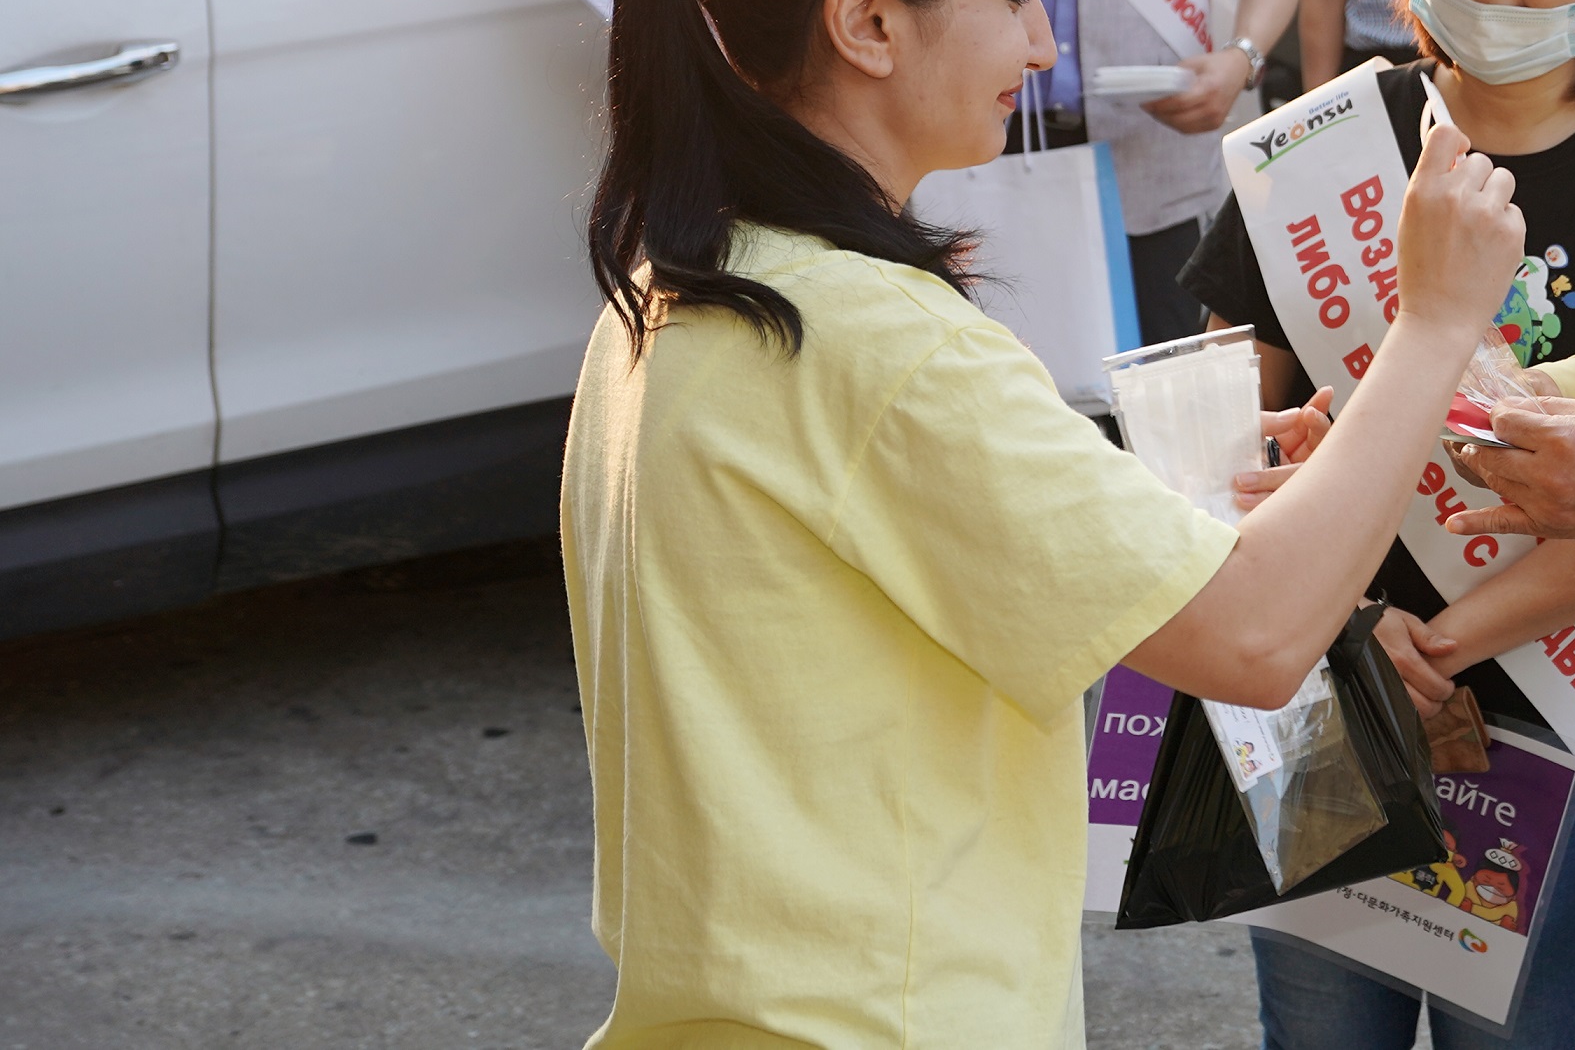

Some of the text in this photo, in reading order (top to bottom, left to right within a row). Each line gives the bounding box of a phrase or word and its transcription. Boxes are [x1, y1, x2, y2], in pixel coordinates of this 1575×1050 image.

[1250, 97, 1353, 160] Yeonsu
[1308, 90, 1350, 115] Better life
[1286, 213, 1350, 329] либо
[1463, 535, 1499, 567] с
[1433, 774, 1516, 827] айте
